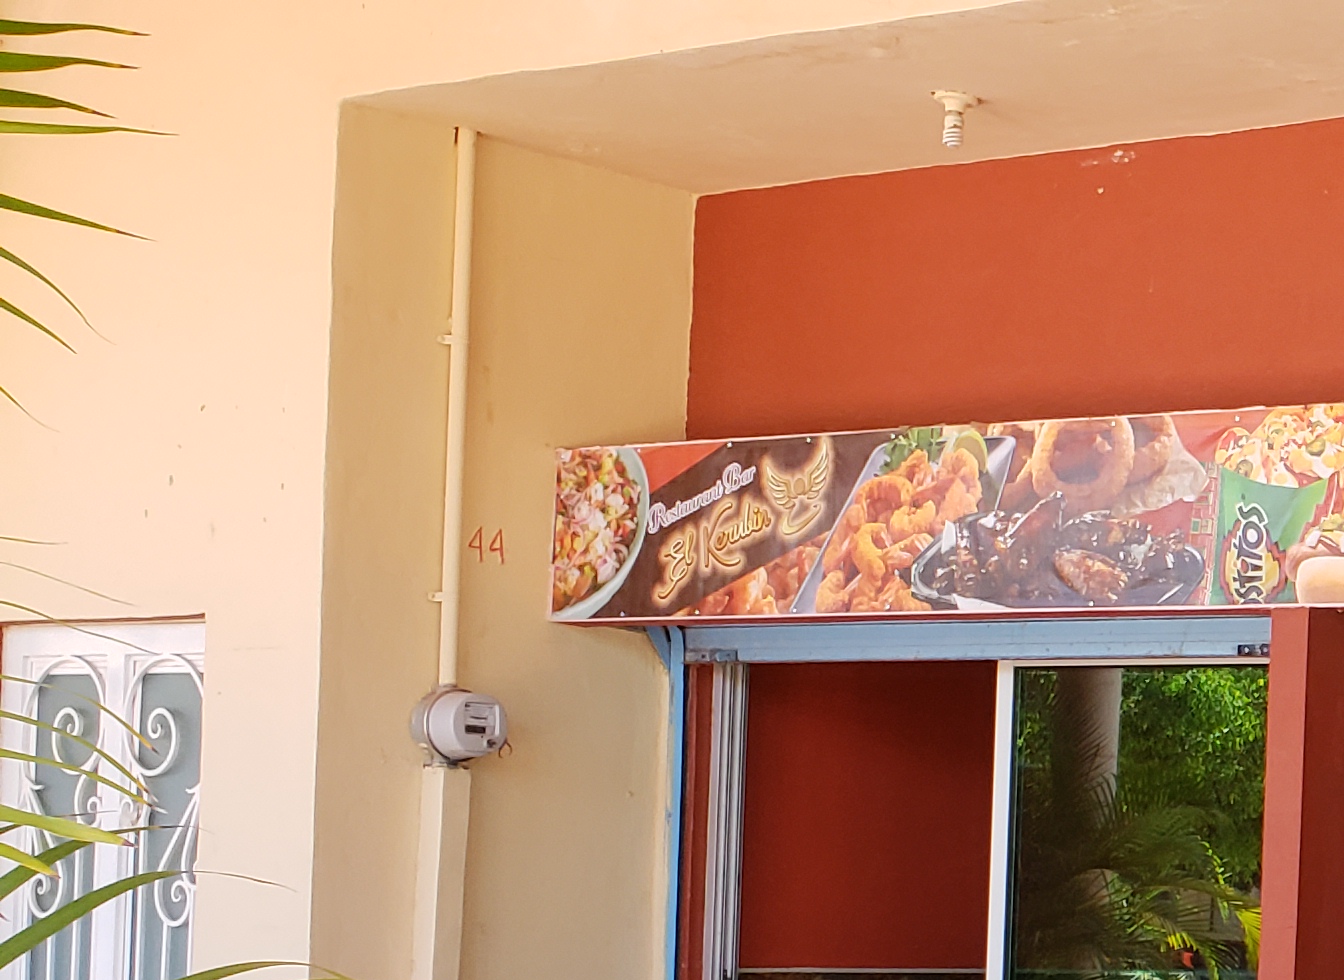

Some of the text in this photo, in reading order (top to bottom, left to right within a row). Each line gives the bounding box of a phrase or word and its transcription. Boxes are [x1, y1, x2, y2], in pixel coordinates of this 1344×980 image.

[648, 462, 757, 535] Restaurant Bar
[468, 526, 505, 565] 44
[657, 502, 772, 600] El Kerubin
